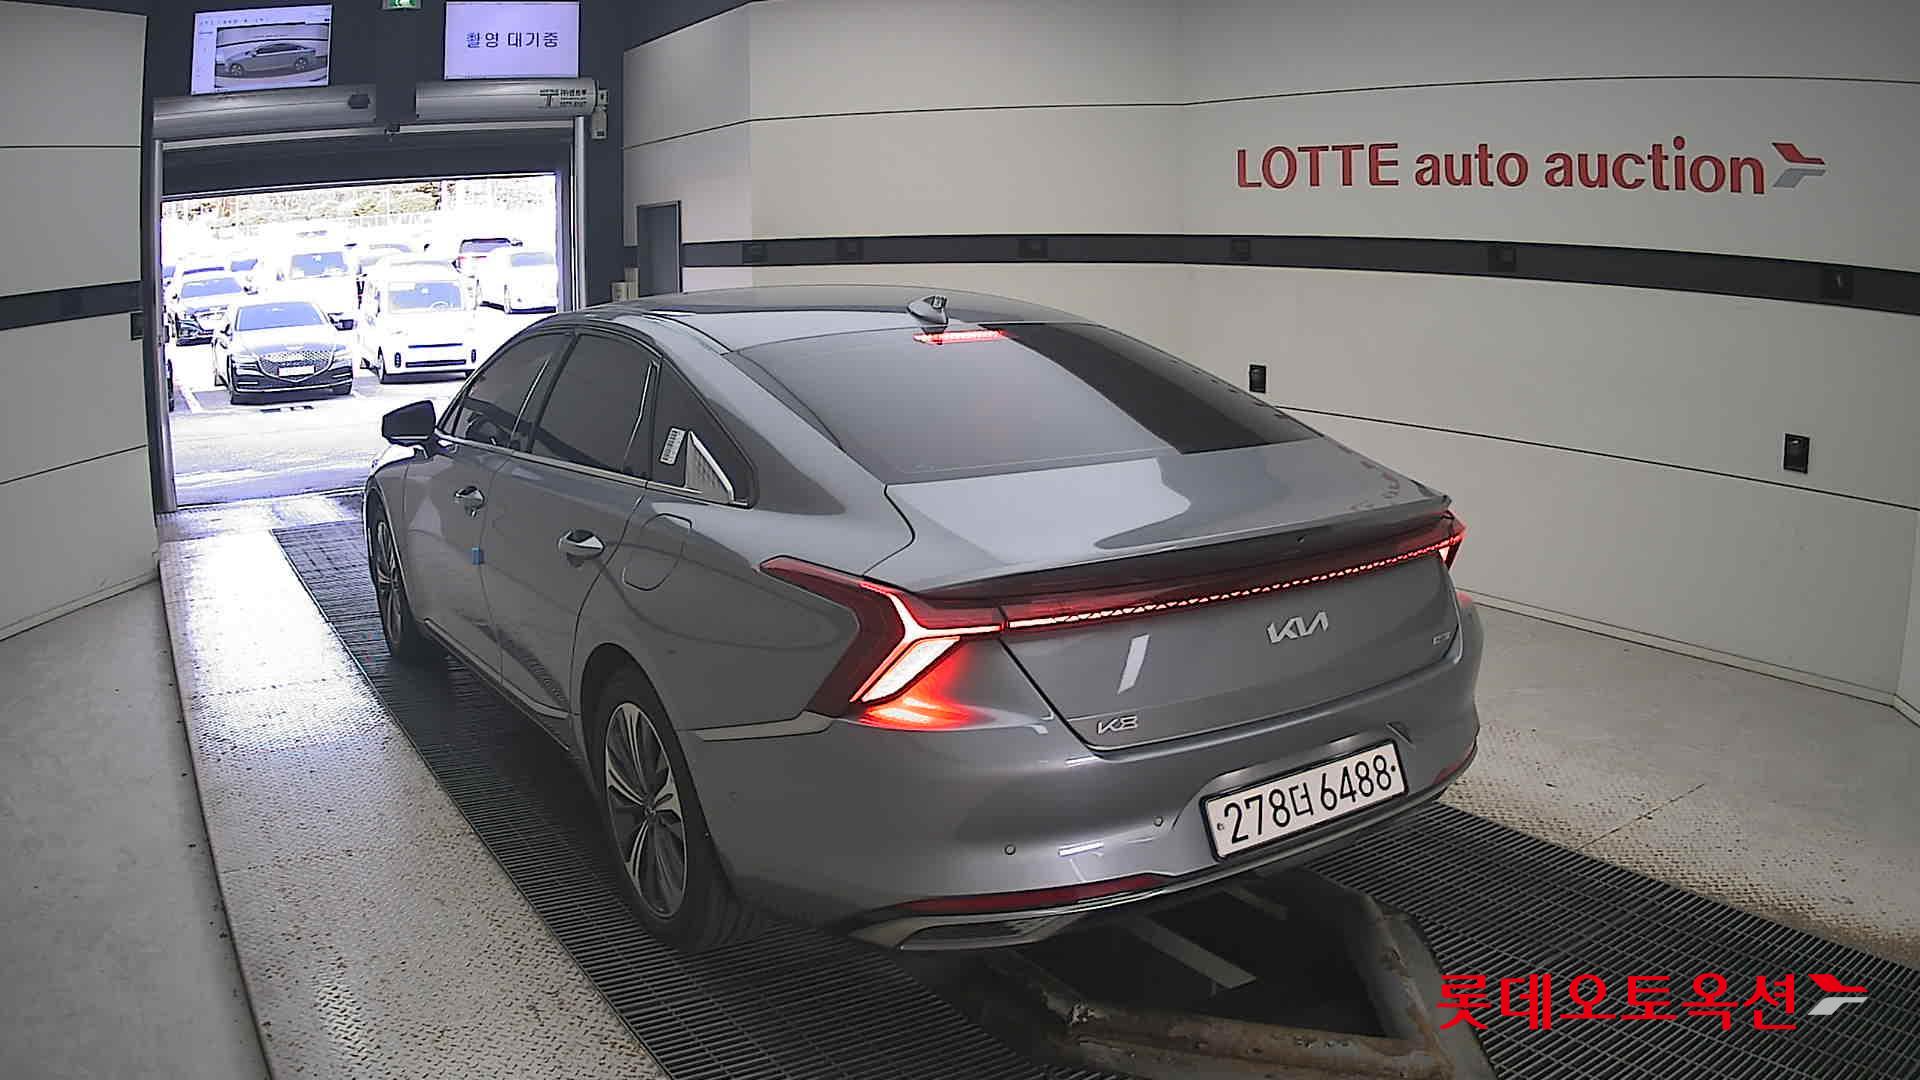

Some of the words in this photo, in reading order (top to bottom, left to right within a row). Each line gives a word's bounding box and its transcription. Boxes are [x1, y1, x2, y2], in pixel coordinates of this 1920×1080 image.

[507, 31, 559, 48] 대기중
[1237, 143, 1399, 189] LOTTE
[1415, 143, 1528, 187] auto
[1544, 136, 1765, 194] auction
[1266, 611, 1329, 643] KIA
[1097, 716, 1138, 735] K8
[1223, 782, 1315, 844] 278더
[1319, 754, 1392, 811] 6488
